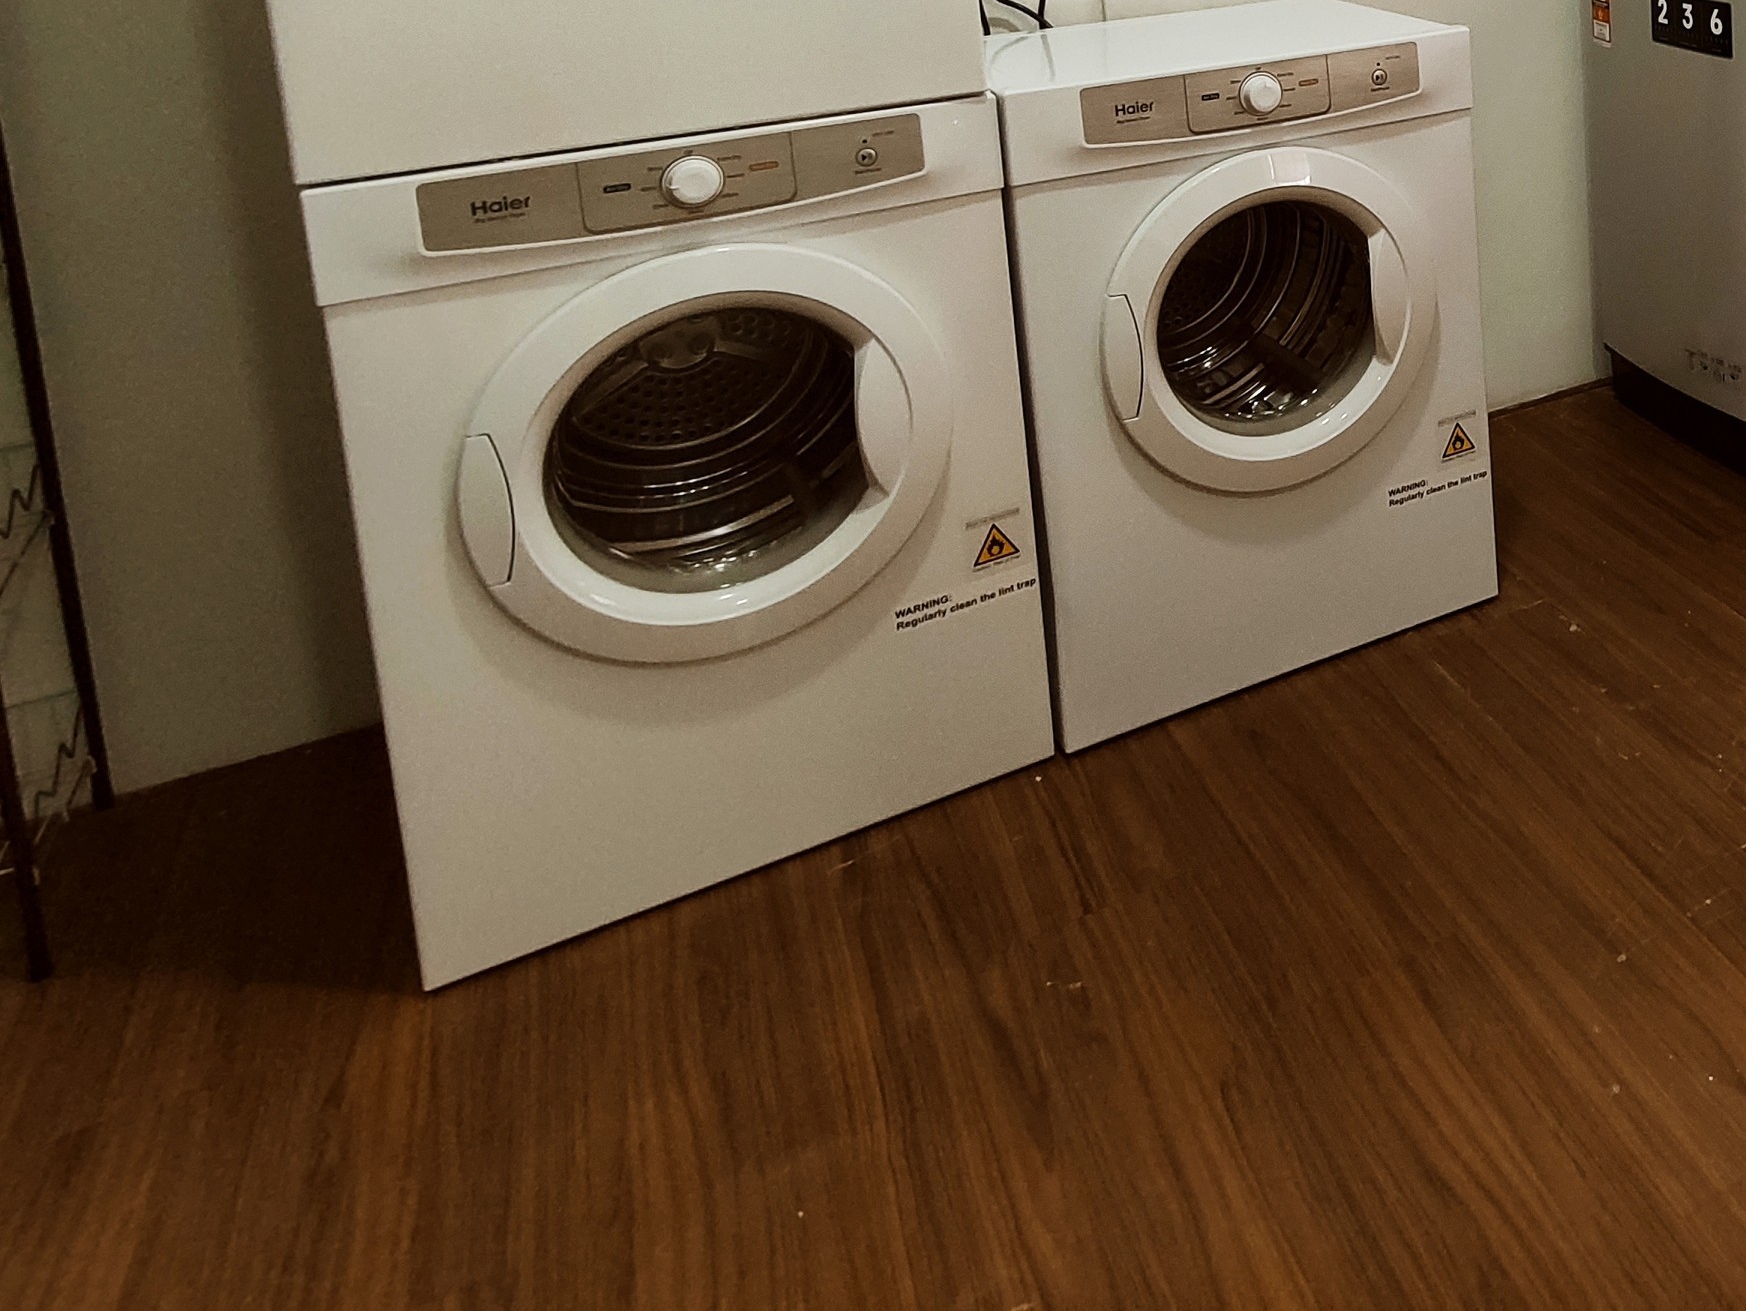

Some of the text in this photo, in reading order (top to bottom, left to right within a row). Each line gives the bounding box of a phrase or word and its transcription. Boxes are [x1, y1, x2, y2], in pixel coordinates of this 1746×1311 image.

[1114, 101, 1154, 117] Haier
[470, 195, 531, 217] Haier
[1388, 470, 1488, 507] Regularly clean the lint trap
[894, 594, 952, 619] WARNING:
[896, 578, 1037, 631] Regularly clean the lint trap
